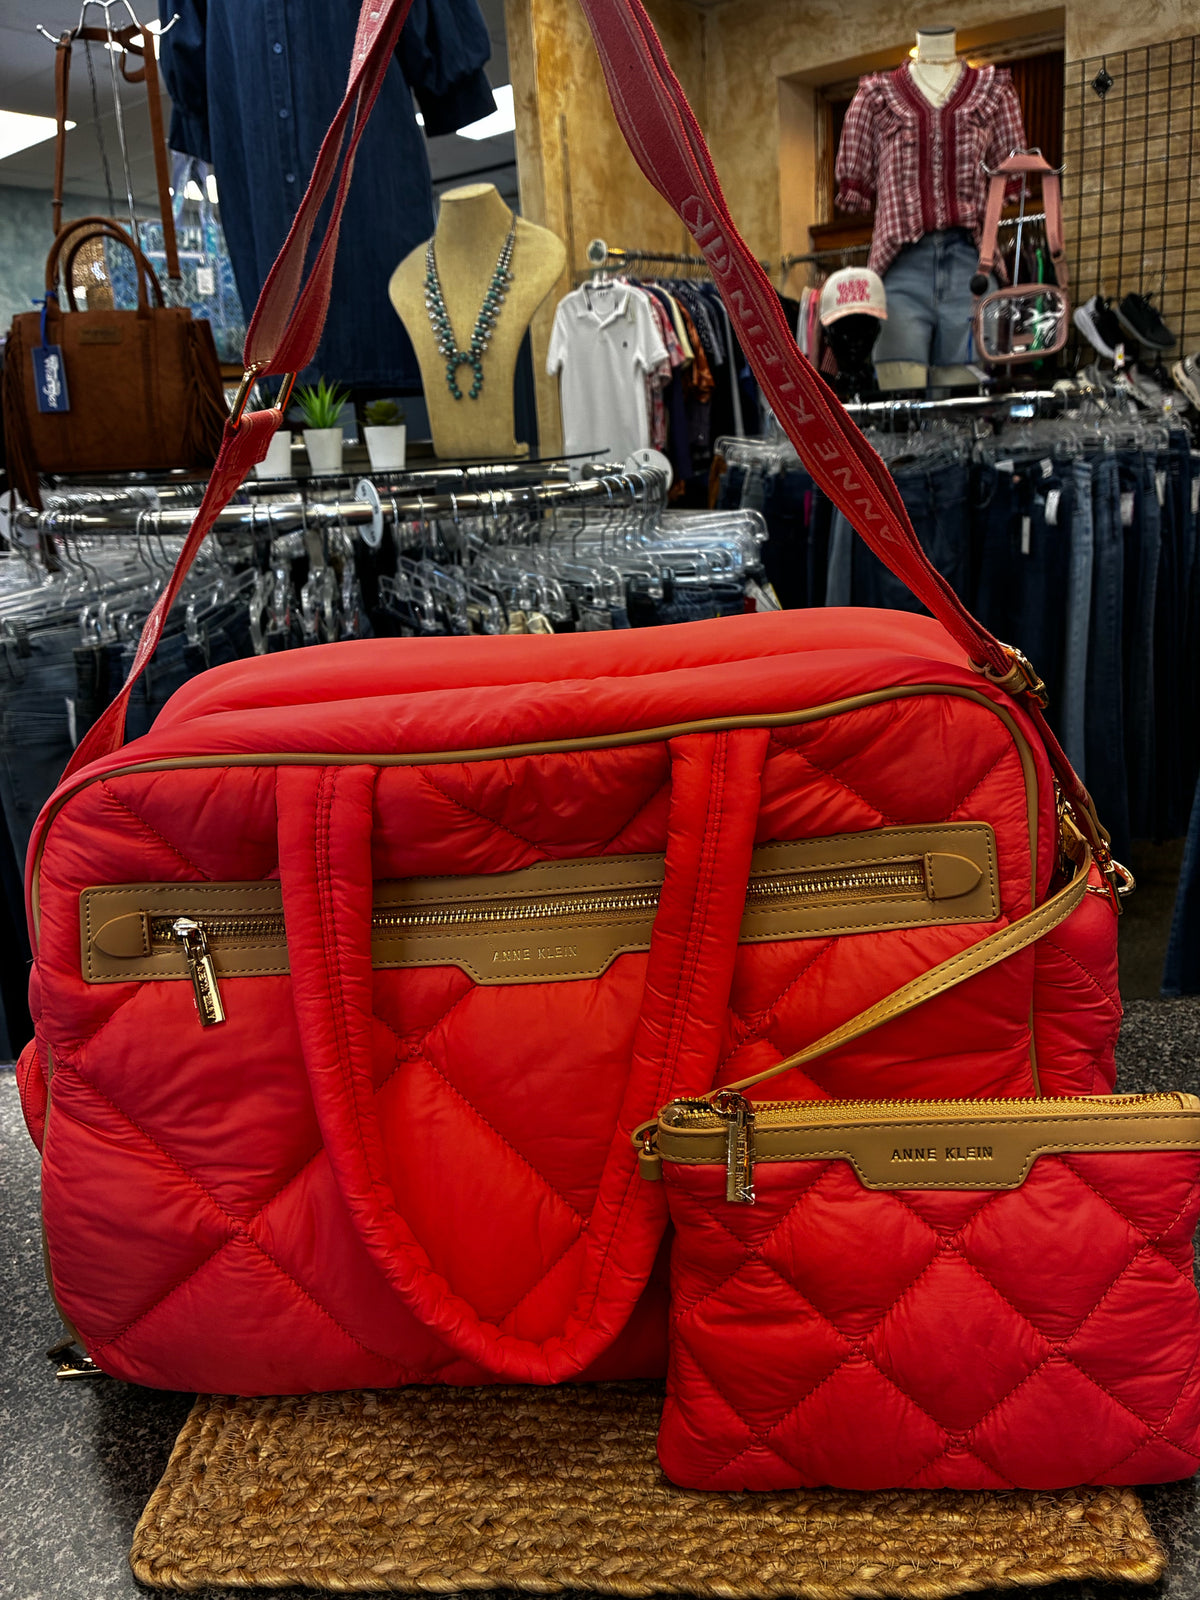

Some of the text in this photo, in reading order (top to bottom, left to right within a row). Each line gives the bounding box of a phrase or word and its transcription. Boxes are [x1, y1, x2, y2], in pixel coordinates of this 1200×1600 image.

[731, 290, 815, 424] KLEIN
[813, 438, 904, 547] ANNE
[493, 945, 577, 963] ANNE KLEIN
[891, 1146, 993, 1162] ANNE KLEIN
